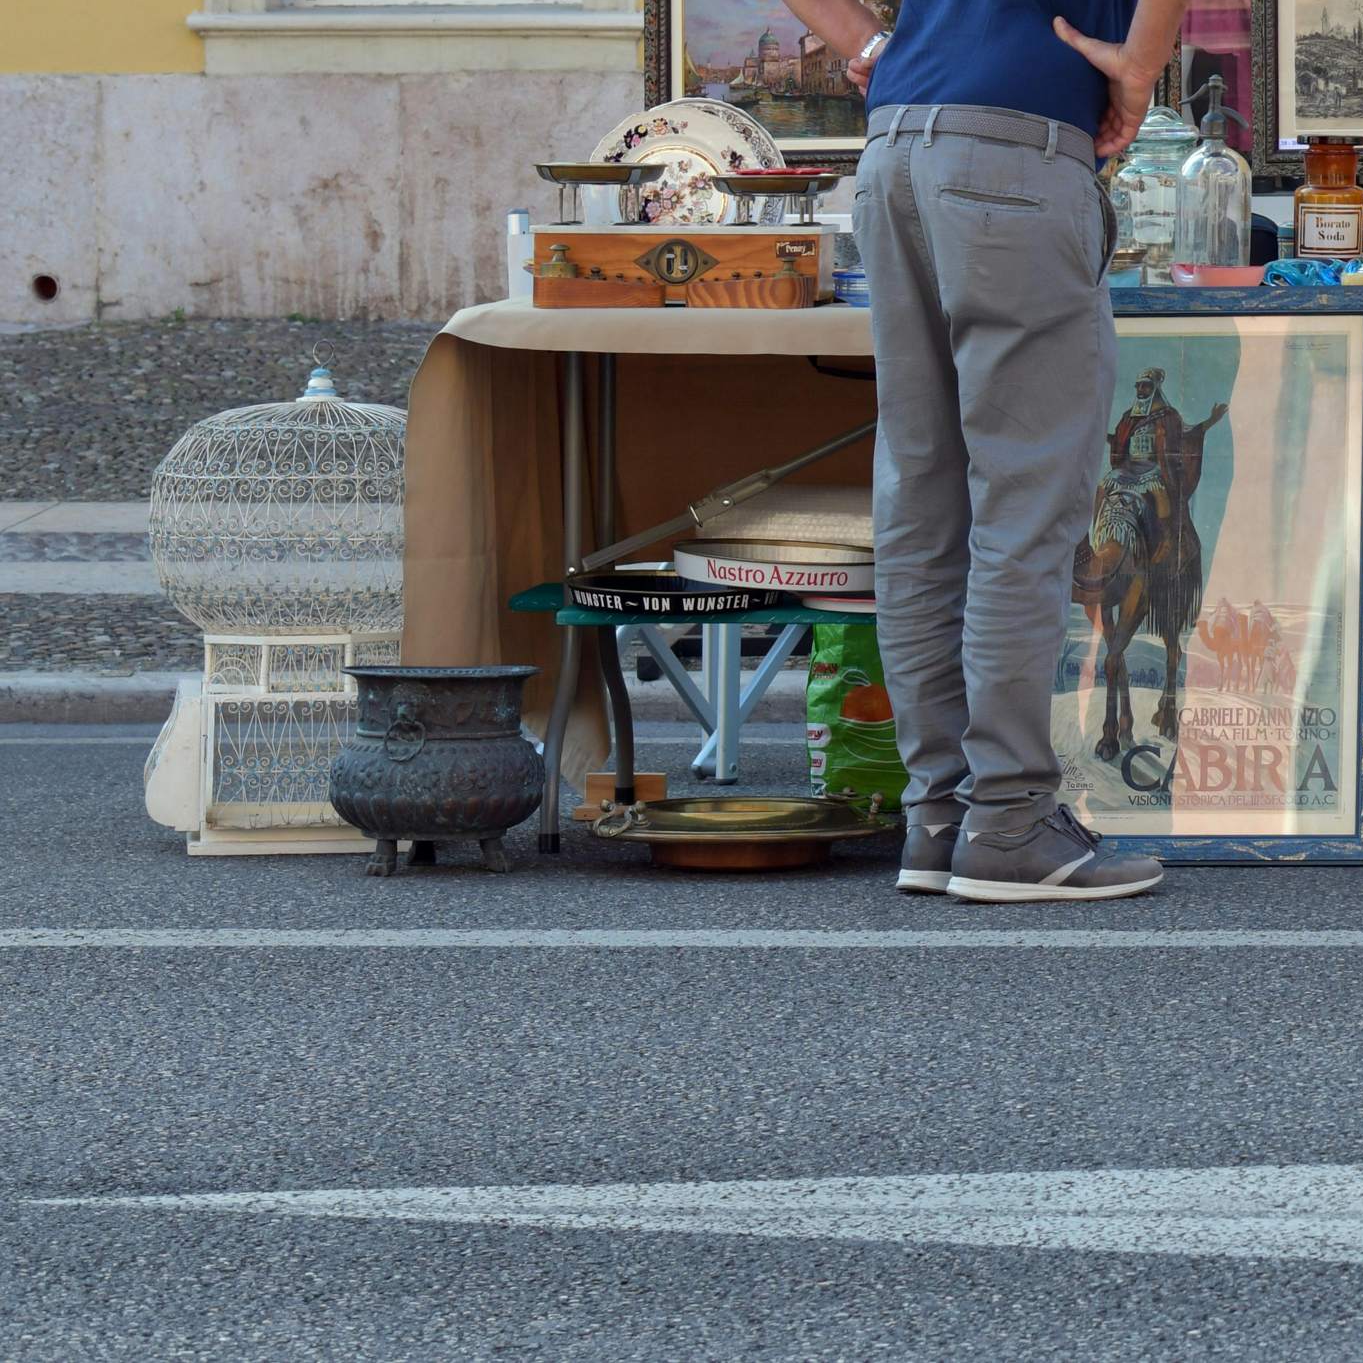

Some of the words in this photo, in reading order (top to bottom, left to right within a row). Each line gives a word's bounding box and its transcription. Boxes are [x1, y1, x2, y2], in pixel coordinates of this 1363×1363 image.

[1314, 217, 1351, 229] Borato
[1317, 230, 1346, 242] Soda
[706, 558, 765, 585] Nastro
[768, 564, 849, 587] Azzurro
[574, 589, 624, 611] WUNSTER
[641, 596, 671, 612] VON
[682, 594, 750, 612] WUNSTER
[1178, 707, 1244, 727] GABRIELE
[1186, 728, 1230, 741] ITALA
[1232, 728, 1268, 741] FILM
[1274, 728, 1331, 741] TORINO
[1128, 794, 1172, 807] VISIONE
[1178, 794, 1227, 806] STORICA
[1227, 794, 1248, 806] DEL
[1264, 794, 1308, 806] SECOLO
